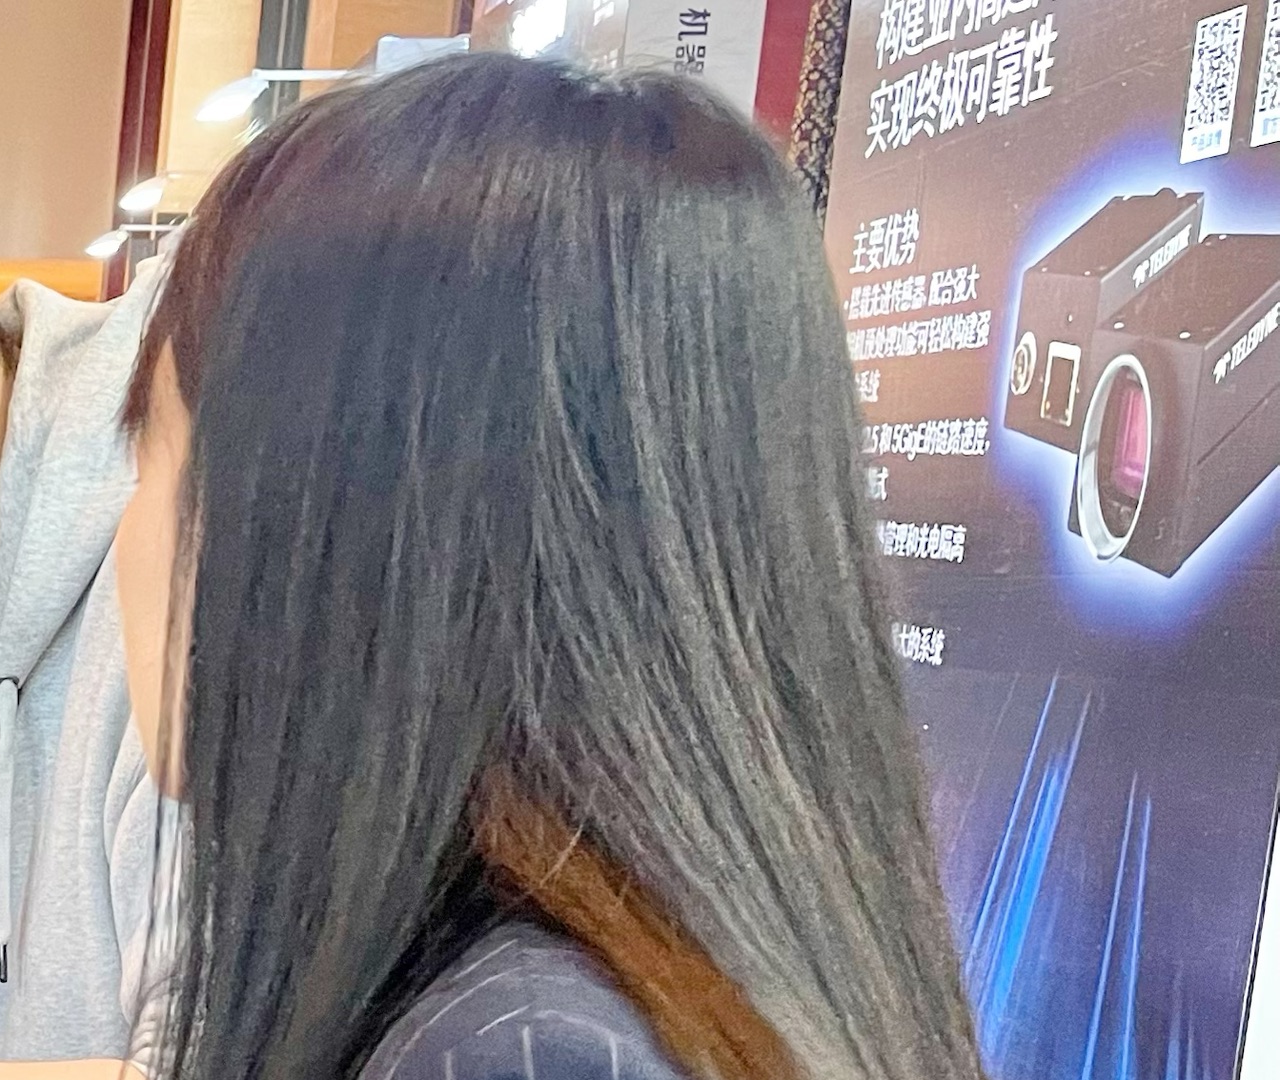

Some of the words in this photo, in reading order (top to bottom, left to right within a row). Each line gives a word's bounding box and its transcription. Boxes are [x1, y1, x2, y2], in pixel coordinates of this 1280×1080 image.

[865, 14, 1058, 158] 实现终极可靠性
[850, 208, 919, 274] 主要优势
[855, 369, 880, 402] 系统
